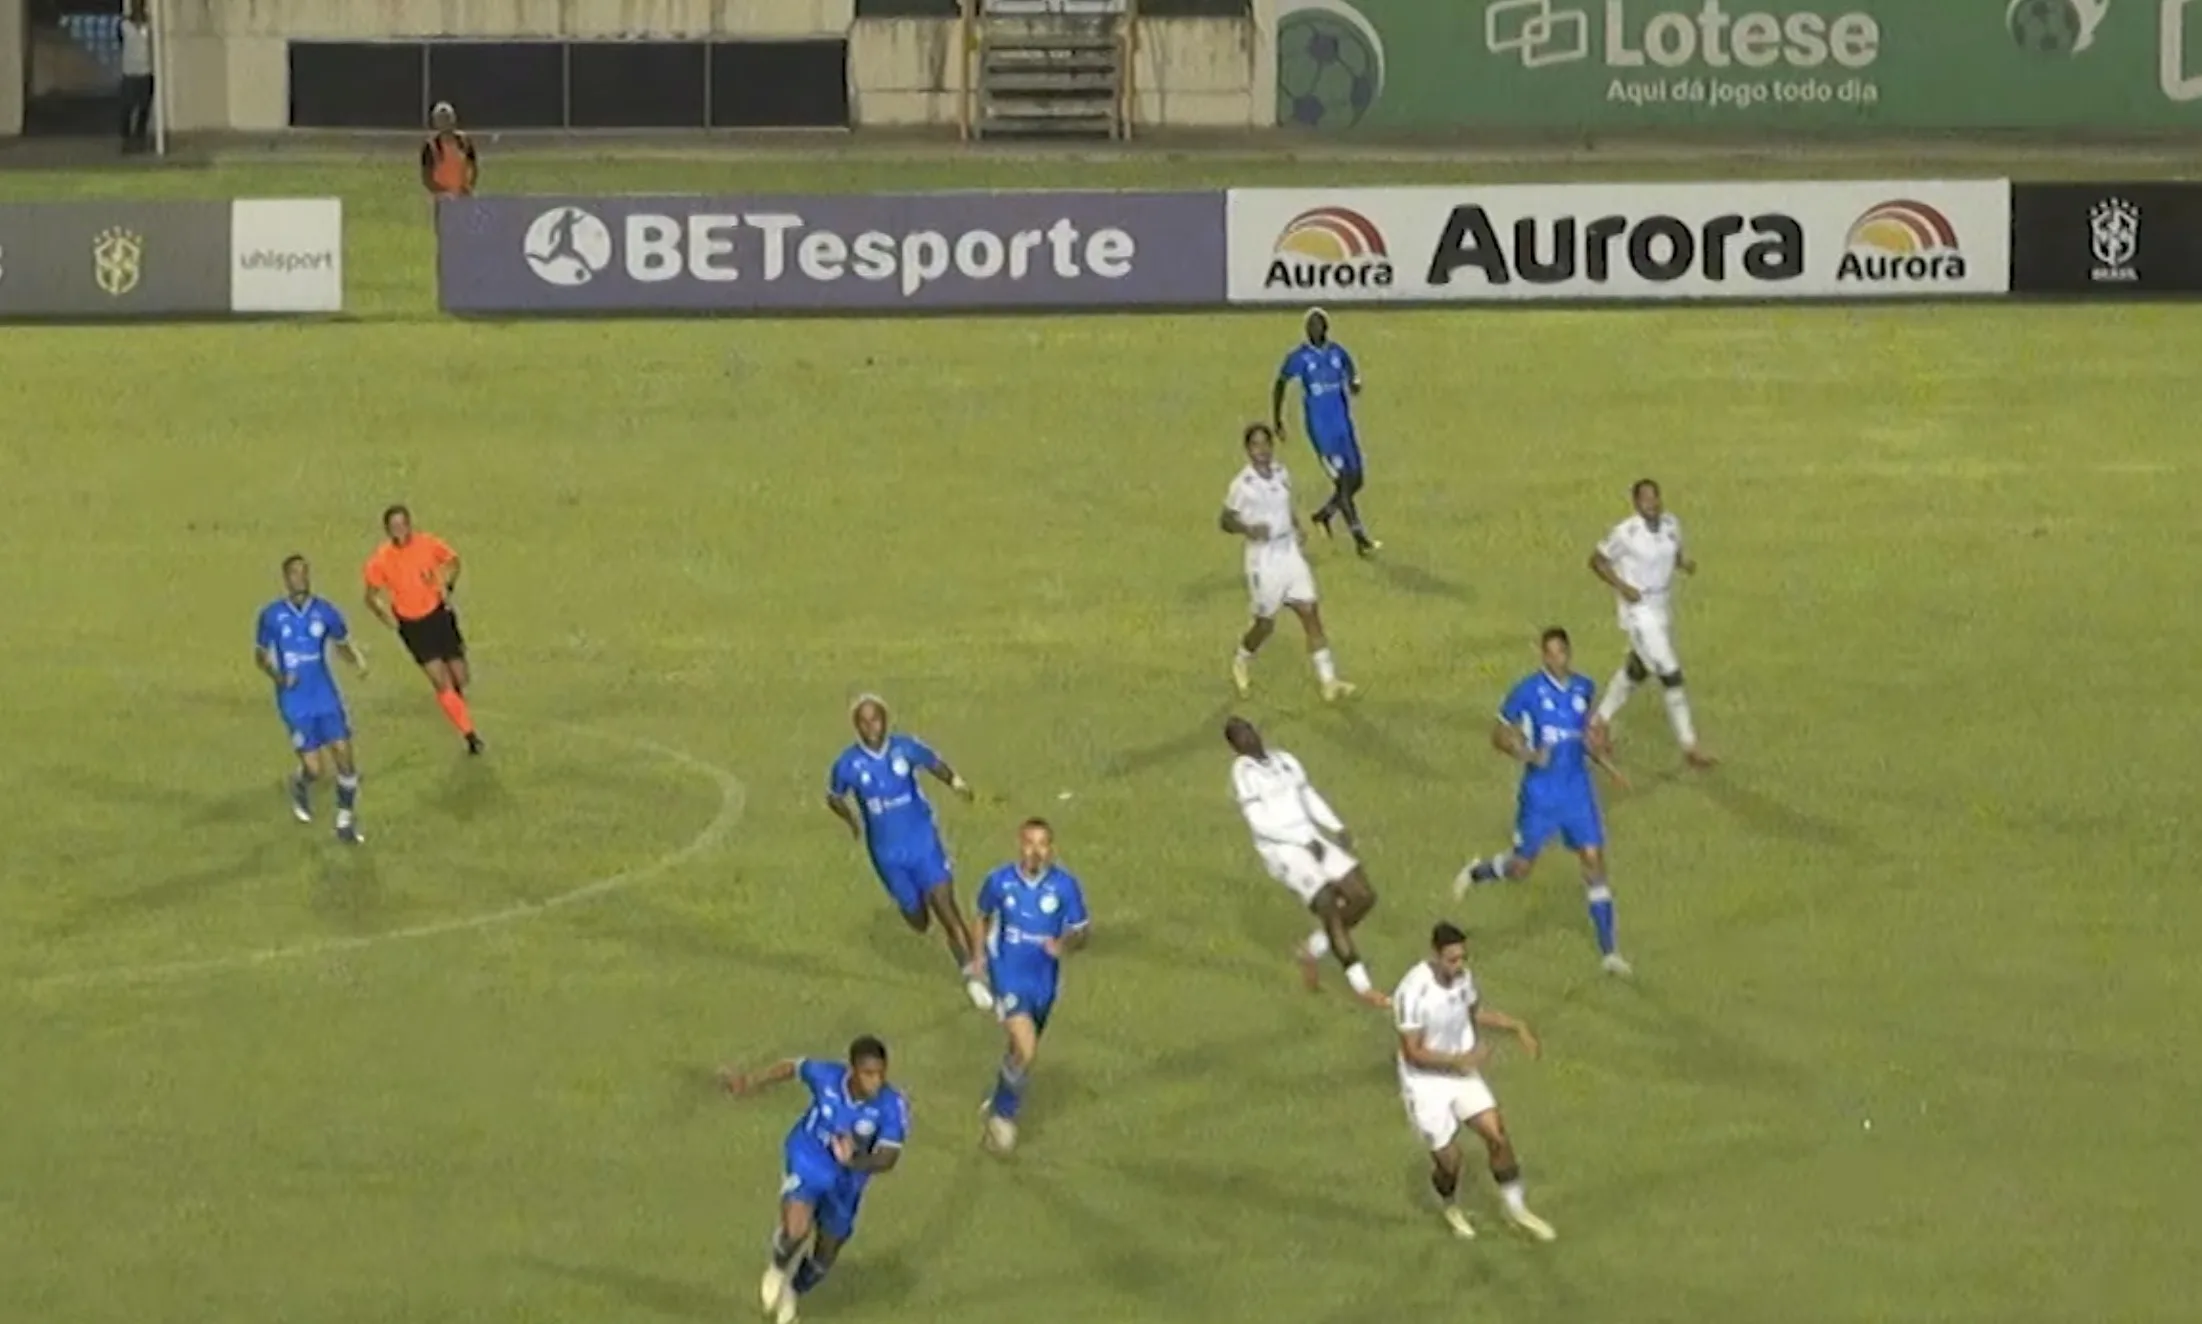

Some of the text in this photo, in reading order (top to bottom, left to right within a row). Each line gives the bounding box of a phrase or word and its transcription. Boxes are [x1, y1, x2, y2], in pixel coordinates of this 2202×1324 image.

[1605, 0, 1880, 68] Lotese
[1607, 78, 1879, 108] Aqui dá jogo todo dia
[624, 213, 1135, 296] BETesporte
[1426, 202, 1804, 283] Aurora
[240, 249, 333, 271] uhlsport
[1264, 258, 1394, 289] Aurora
[1836, 251, 1967, 281] Aurora
